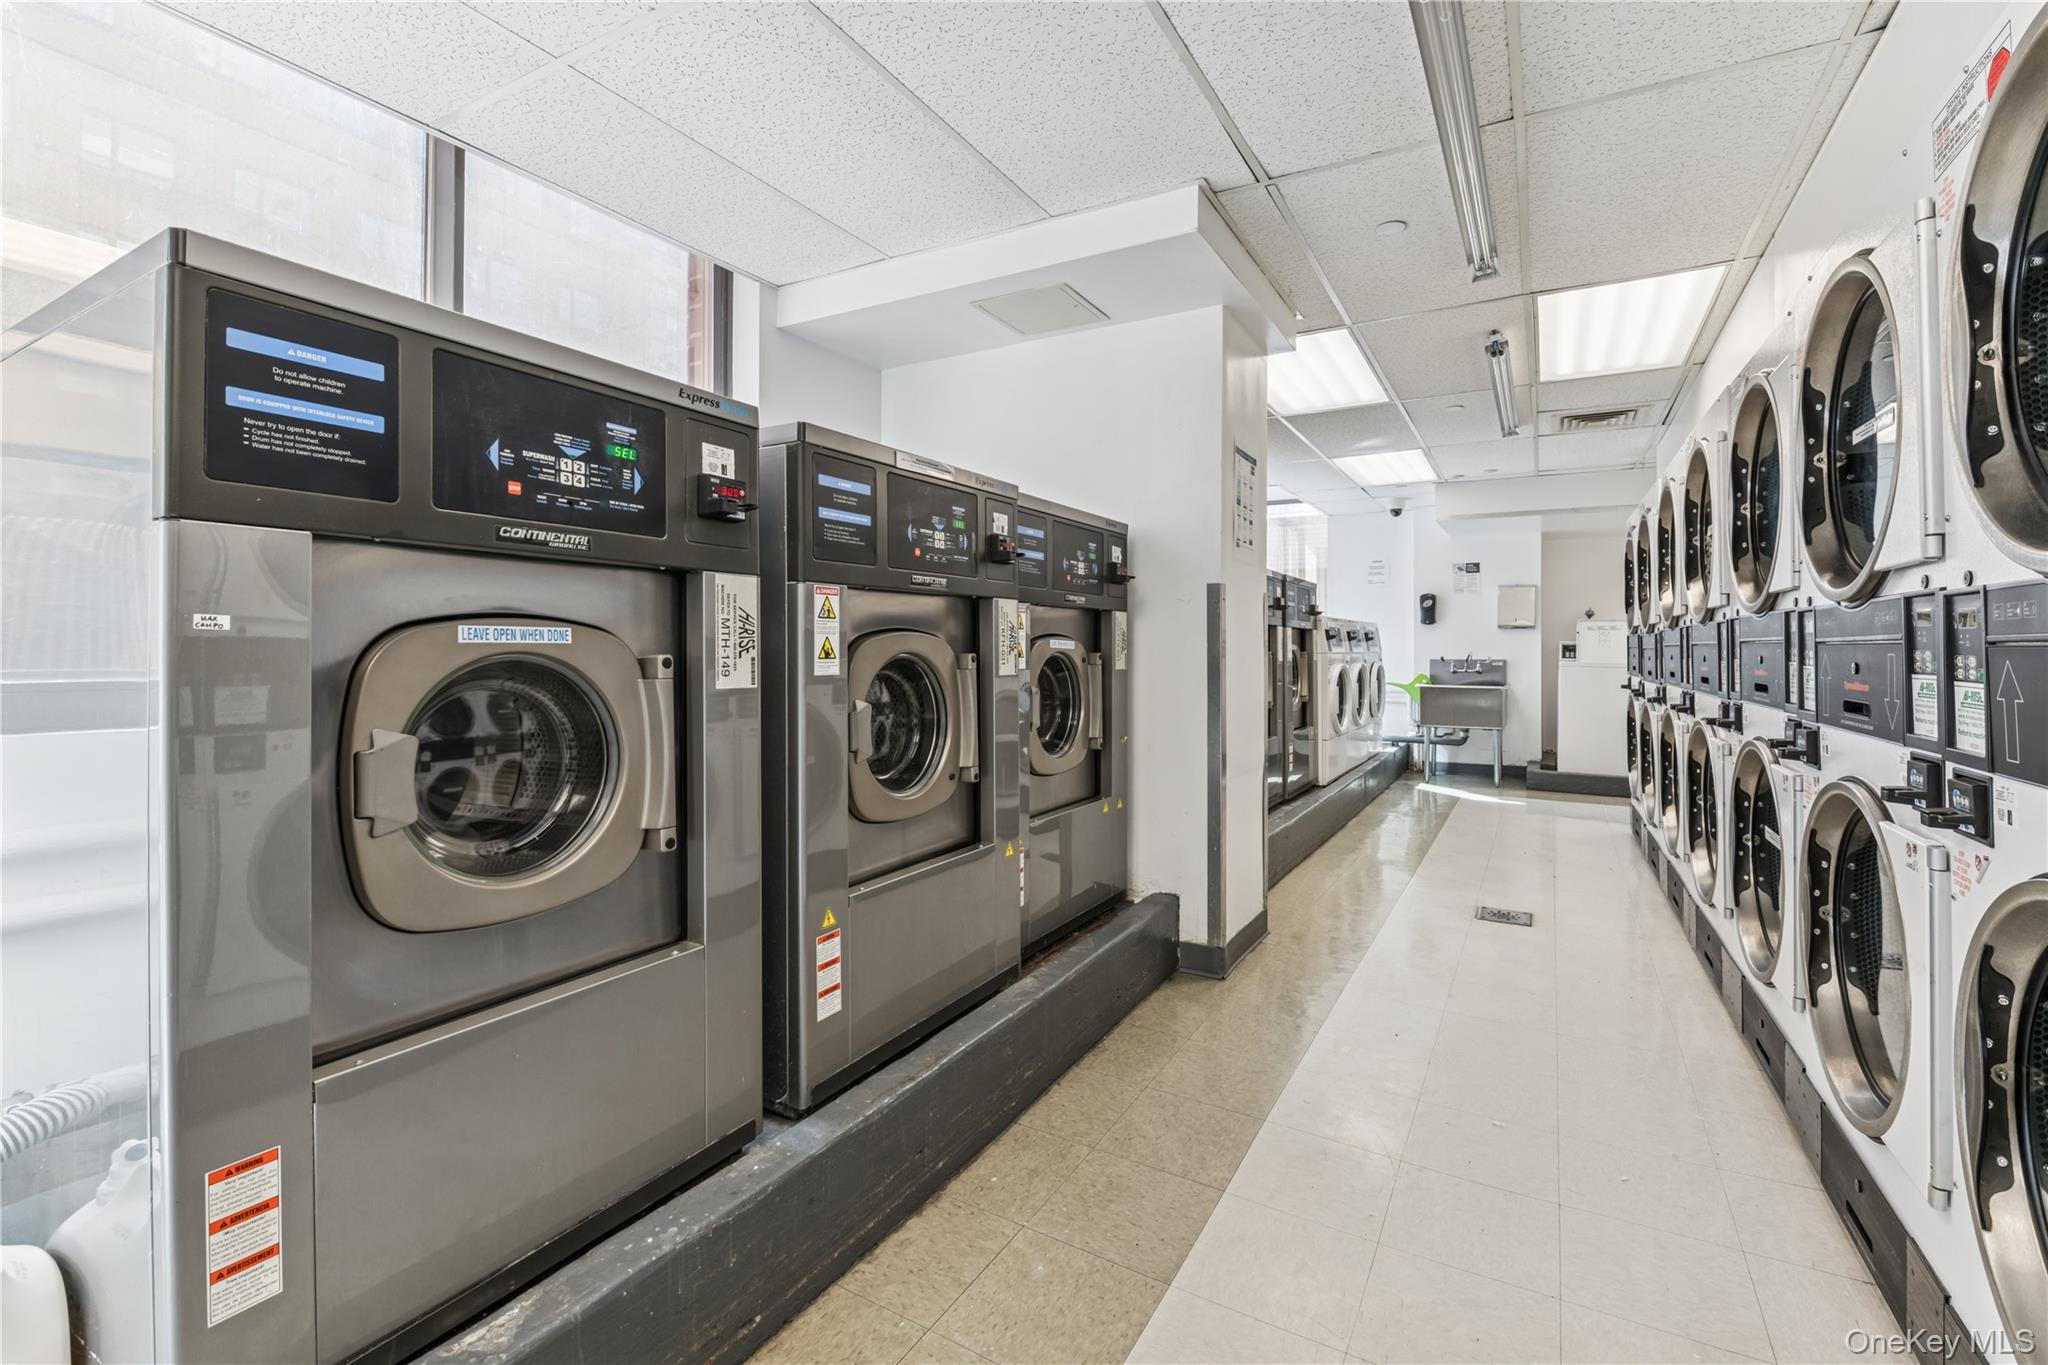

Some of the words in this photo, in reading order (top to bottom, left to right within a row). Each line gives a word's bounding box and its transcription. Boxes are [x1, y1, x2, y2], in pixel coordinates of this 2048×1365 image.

[296, 349, 328, 364] DANGER
[271, 366, 284, 375] Do
[285, 369, 298, 378] not
[298, 371, 318, 382] allow
[318, 376, 346, 389] children
[274, 374, 283, 382] to
[283, 376, 312, 389] operate
[312, 381, 344, 395] machine.
[292, 404, 306, 413] WITH
[243, 416, 266, 428] Never
[266, 421, 278, 430] try
[278, 422, 286, 430] to
[286, 424, 305, 436] open
[305, 426, 316, 436] the
[317, 428, 334, 439] door
[251, 427, 270, 437] Cycle
[270, 430, 283, 438] has
[294, 434, 320, 445] finished.
[251, 434, 270, 444] Drum
[270, 437, 283, 446] has
[284, 440, 294, 448] not
[294, 442, 326, 454] completely
[327, 447, 352, 458] stopped.
[251, 442, 270, 451] Water
[272, 444, 284, 453] has
[284, 447, 296, 455] not
[296, 448, 312, 458] been
[312, 451, 344, 463] completely
[344, 456, 368, 466] drained.
[522, 450, 556, 462] SUPERWASH
[499, 526, 591, 546] CONTINENTAL
[194, 622, 224, 630] CAMPO
[461, 627, 490, 640] LEAVE
[492, 628, 517, 641] OPEN
[520, 628, 545, 642] WHEN
[547, 629, 570, 642] DONE
[738, 606, 756, 660] HI-RISE
[720, 618, 731, 678] MTH-149
[234, 1156, 264, 1172] WARNING
[230, 1202, 270, 1225] ADVERTENCIA
[226, 1248, 275, 1276] AVERTISSEMENT
